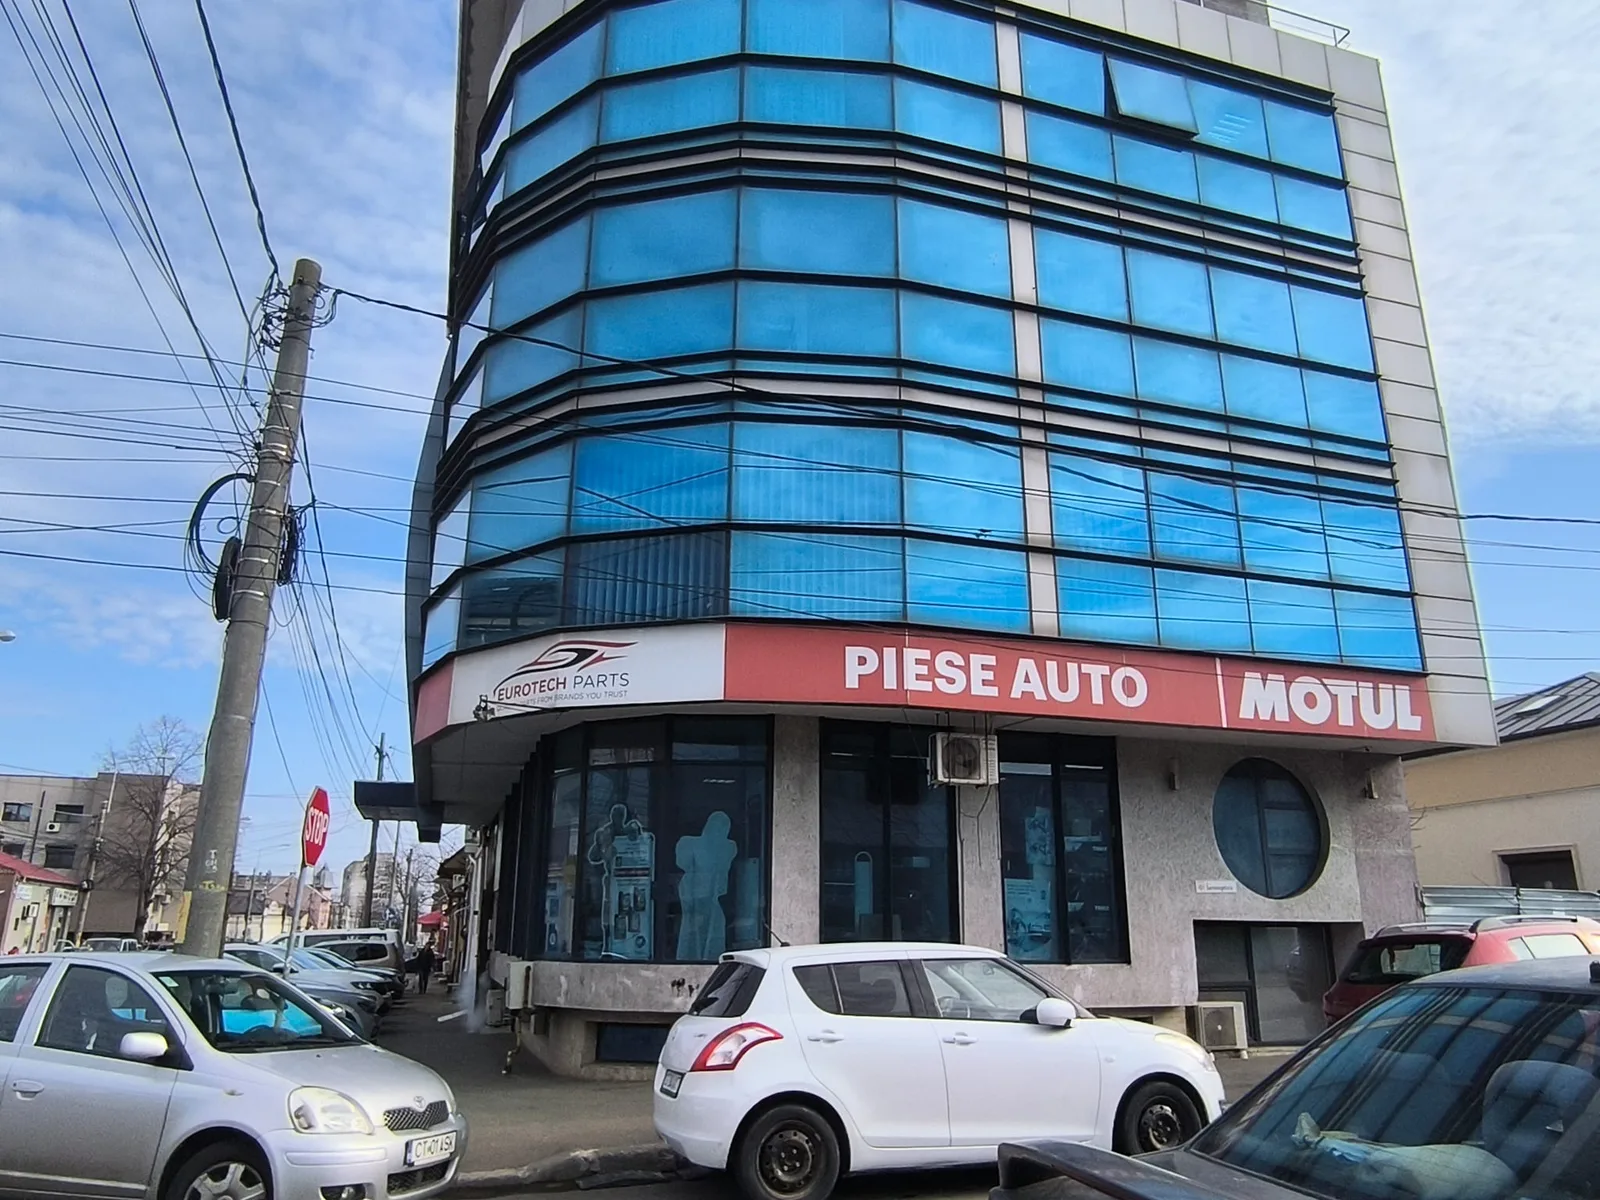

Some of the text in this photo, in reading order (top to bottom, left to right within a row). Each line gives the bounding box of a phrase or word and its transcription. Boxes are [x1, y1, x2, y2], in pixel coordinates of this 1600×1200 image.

[497, 672, 630, 701] EUROTECH PARTS
[554, 692, 584, 702] BRANDS
[586, 691, 602, 700] YOU
[604, 690, 628, 699] TRUST
[845, 646, 1148, 708] PIESE AUTO
[1239, 671, 1422, 731] MOTUL
[305, 807, 328, 846] STOP
